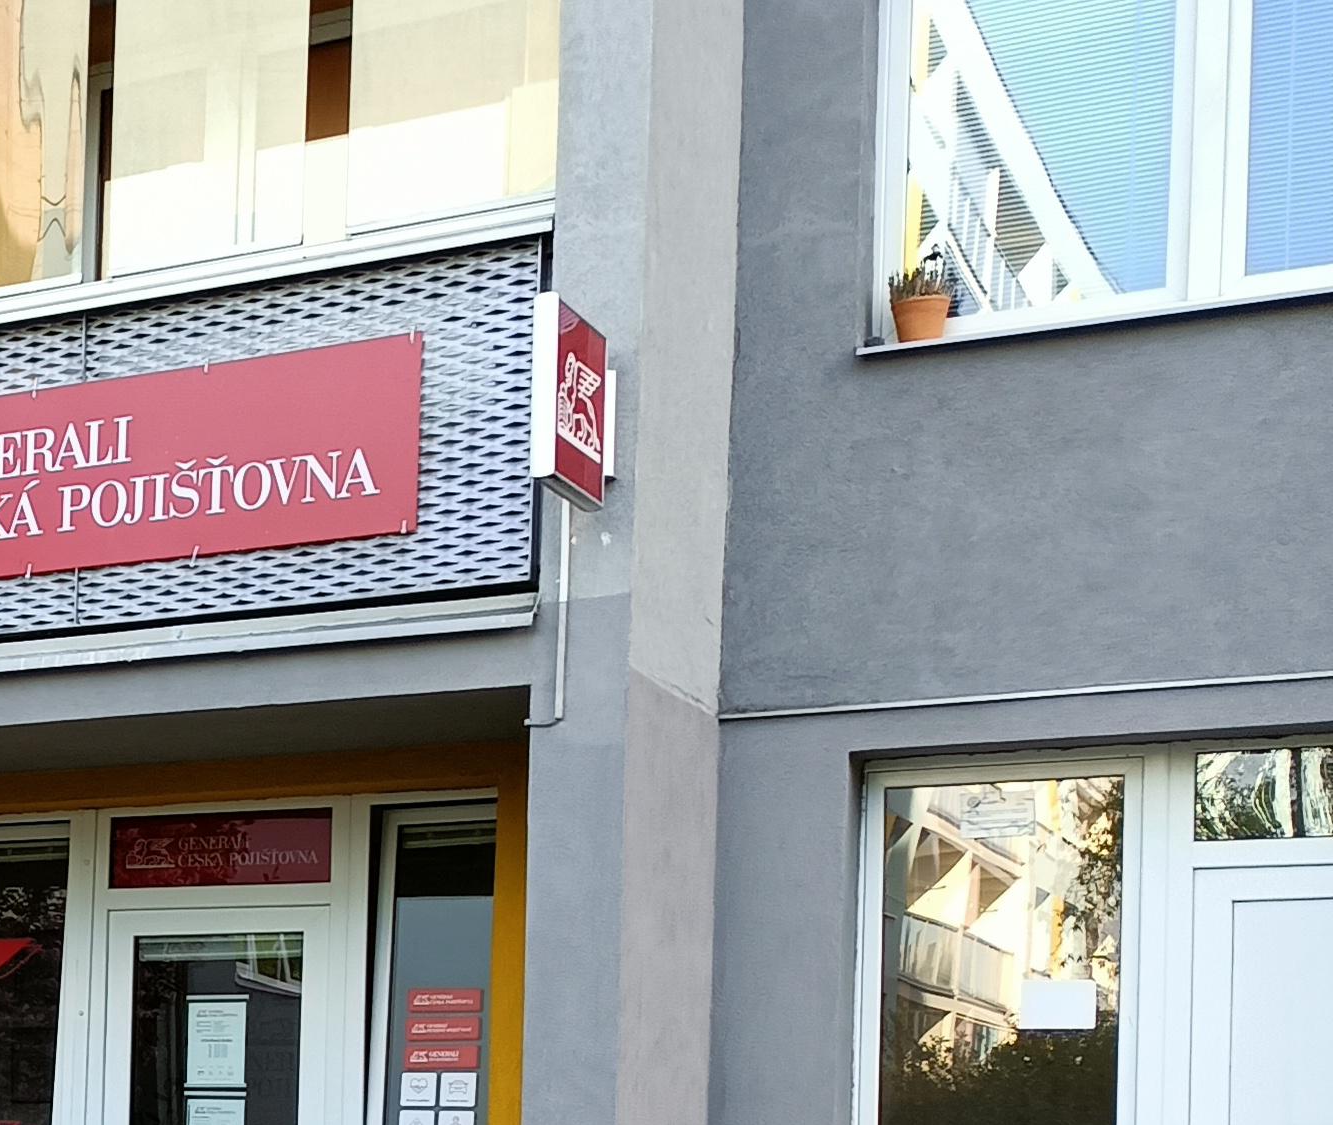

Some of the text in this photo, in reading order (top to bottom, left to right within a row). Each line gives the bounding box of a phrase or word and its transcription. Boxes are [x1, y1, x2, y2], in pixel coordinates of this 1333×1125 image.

[56, 447, 381, 533] POJIŠŤOVNA
[178, 832, 250, 851] GENERALI
[229, 846, 319, 867] POJIŠŤOVNA
